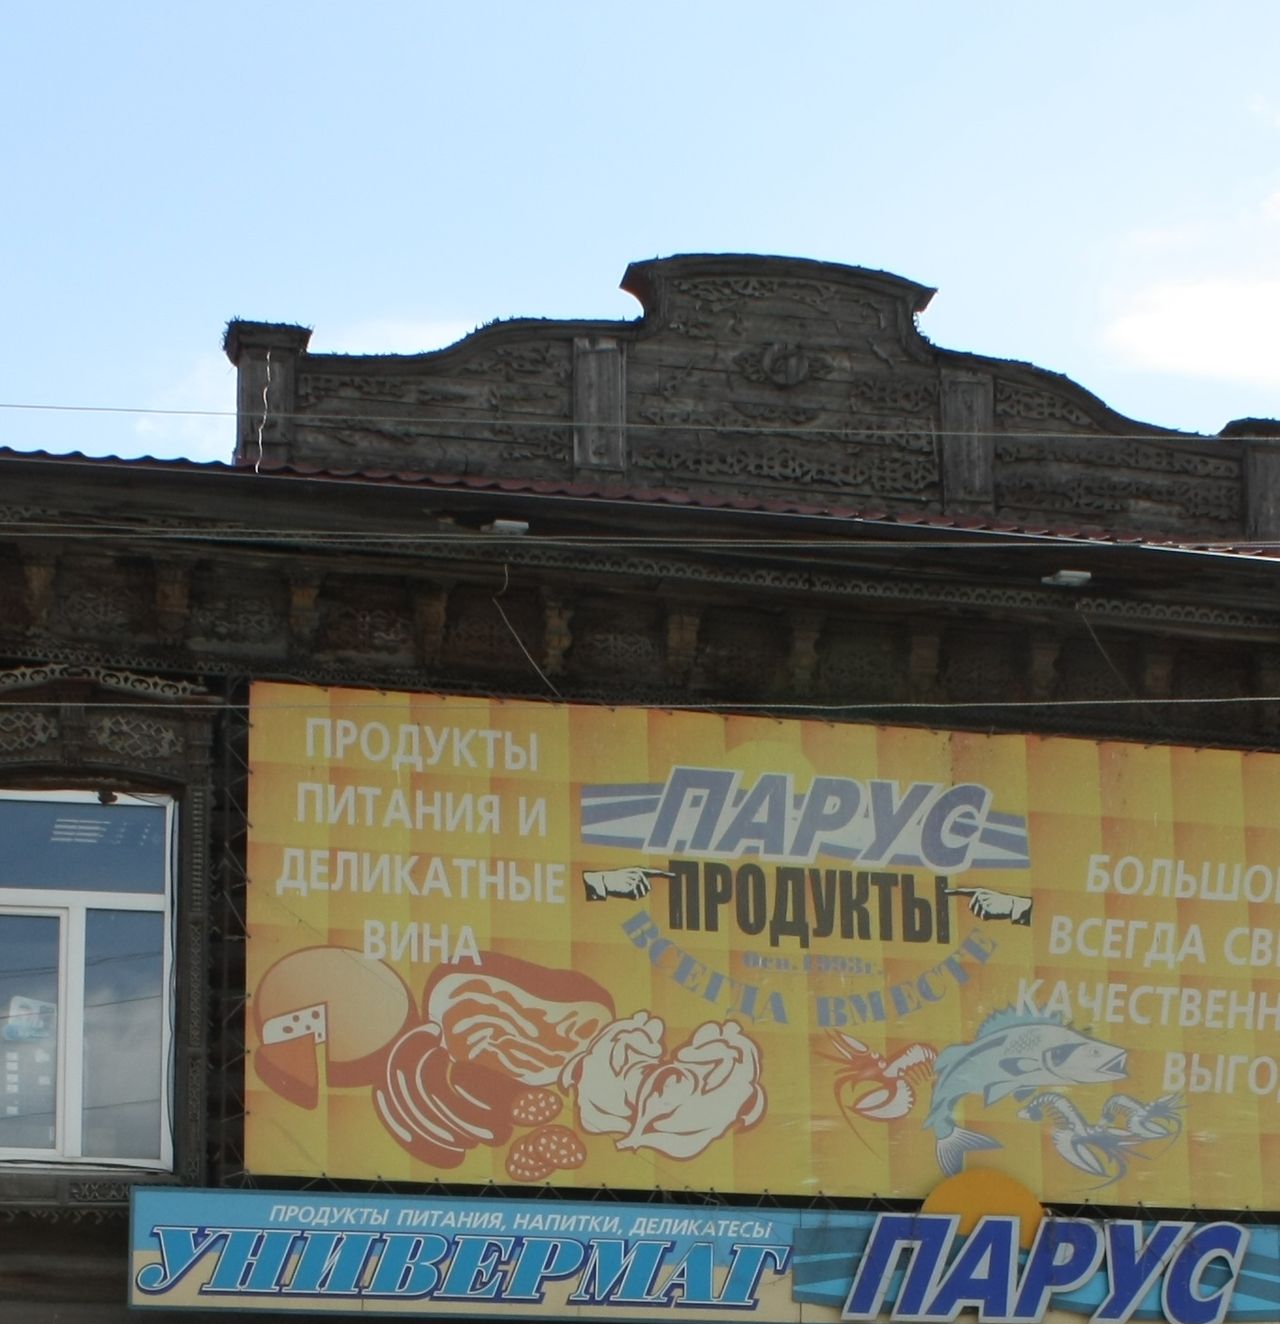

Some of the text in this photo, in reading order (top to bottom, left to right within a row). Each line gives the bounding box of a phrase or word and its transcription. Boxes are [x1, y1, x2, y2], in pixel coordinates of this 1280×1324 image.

[305, 718, 538, 772] ПРОДУКТЫ
[296, 782, 547, 837] ПИТАНИЯ И
[641, 765, 994, 875] ПАРУС
[276, 847, 566, 904] ДЕЛИКАТНЫЕ
[668, 859, 951, 949] ПРОДУКТЫ
[364, 919, 483, 966] ВИНА
[621, 910, 998, 1027] ВСЕГДА ВМЕСТЕ
[1048, 915, 1206, 969] ВСЕГДА
[269, 1205, 772, 1239] ПРОДУКТЫ ПИТАНИЯ, НАПИТКИ, ДЕЛИКАТЕСЫ
[135, 1225, 793, 1311] УНИВЕРМАГ
